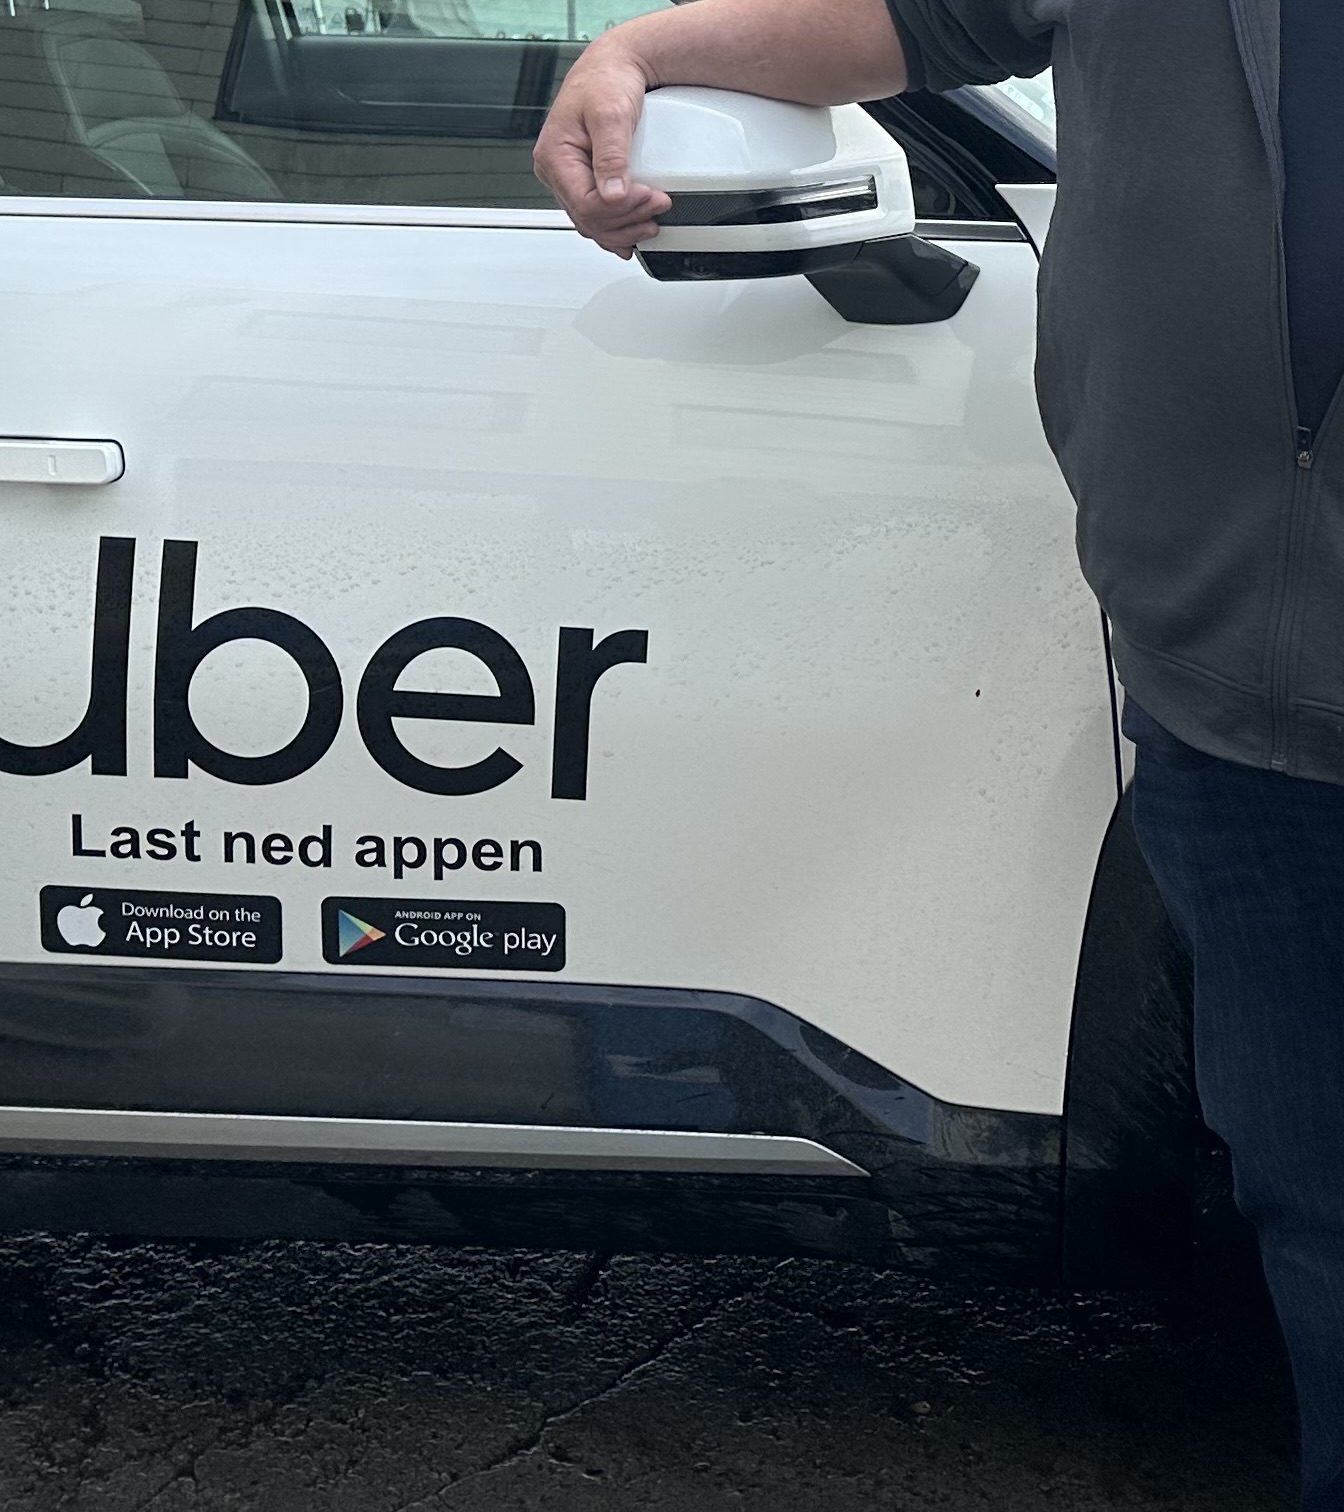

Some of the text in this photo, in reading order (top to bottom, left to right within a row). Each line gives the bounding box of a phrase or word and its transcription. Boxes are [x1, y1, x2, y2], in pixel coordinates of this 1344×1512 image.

[71, 813, 543, 881] Last ned appen
[121, 901, 261, 923] Download on the
[394, 910, 481, 921] ANDROID APP ON
[125, 920, 256, 949] App Store
[394, 922, 557, 956] Google play
